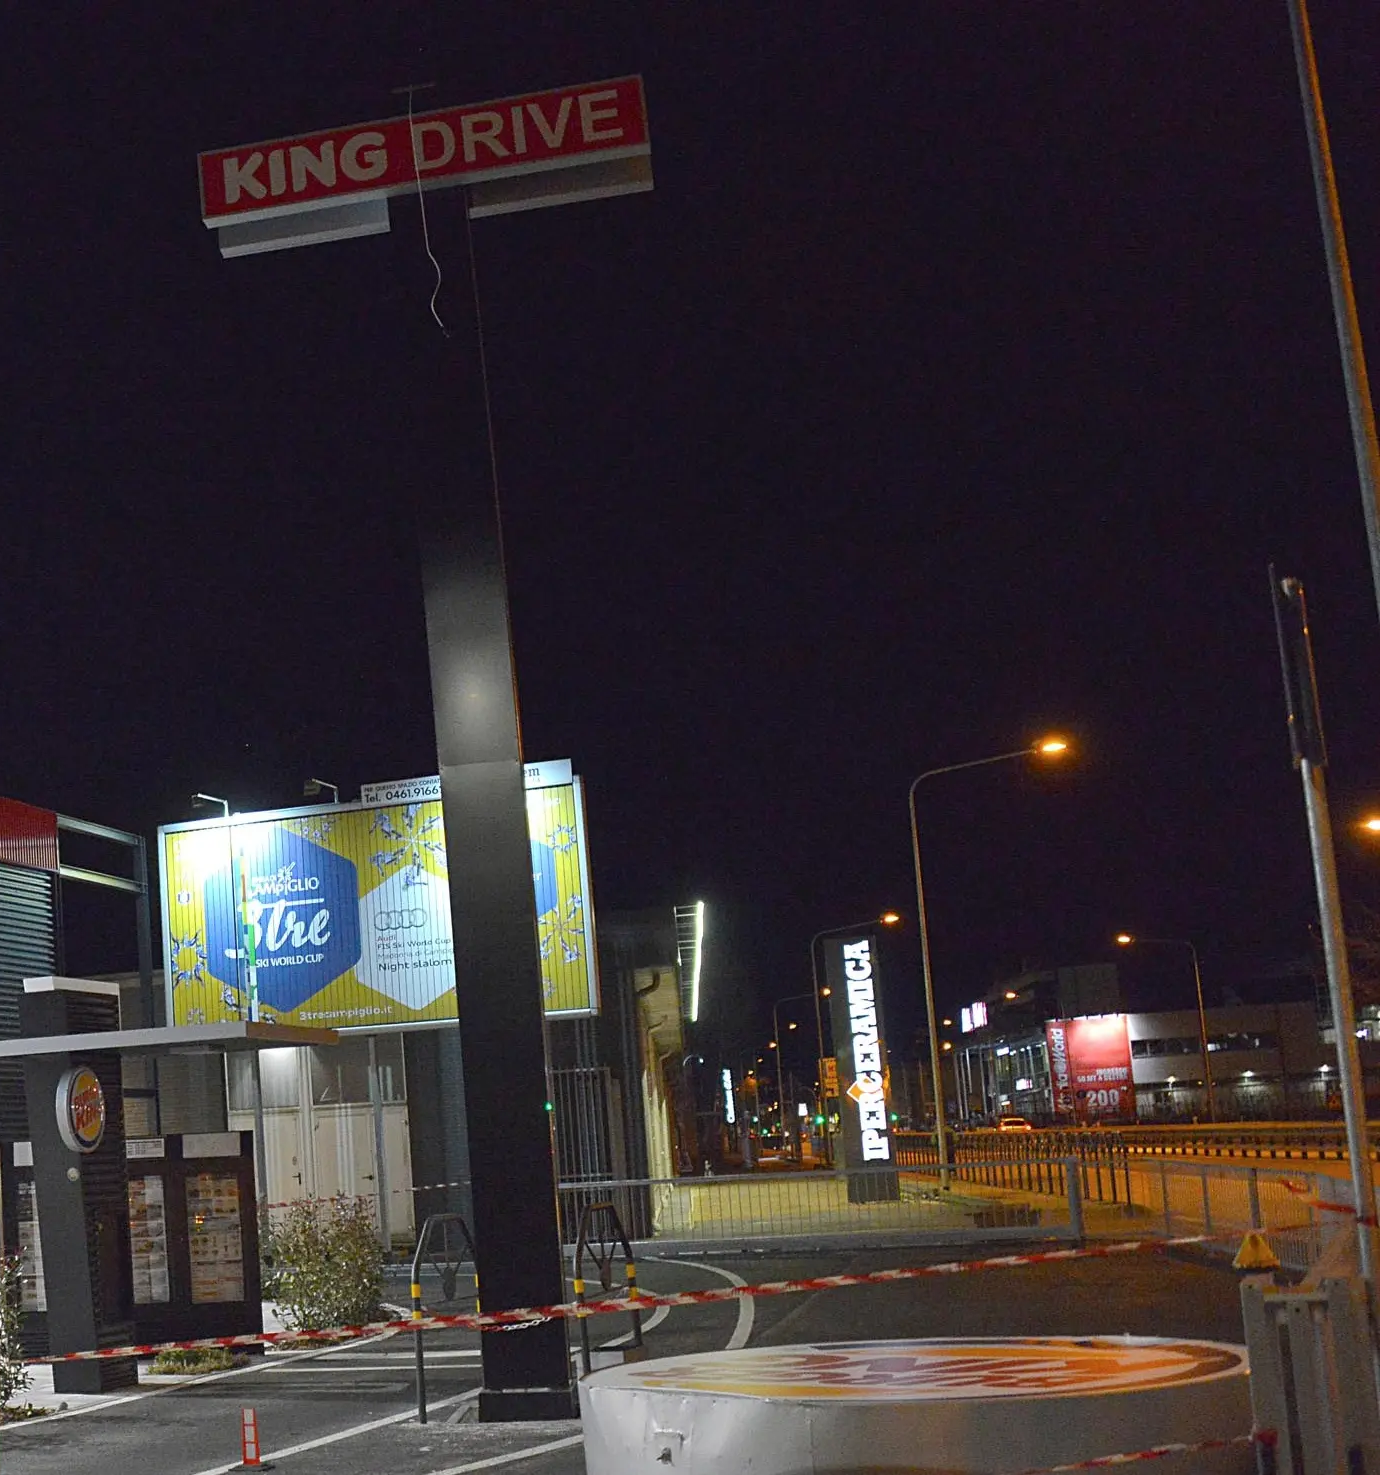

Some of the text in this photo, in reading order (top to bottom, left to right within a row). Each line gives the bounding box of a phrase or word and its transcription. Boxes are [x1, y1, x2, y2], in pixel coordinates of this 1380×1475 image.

[222, 89, 624, 204] KING DRIVE
[364, 785, 442, 803] Tel. 0461.9166
[407, 939, 433, 947] World
[434, 937, 452, 945] Cup
[256, 953, 325, 969] SKI WORLD CUP
[378, 958, 453, 972] Night slalom
[843, 939, 890, 1161] IPERCERAMICA
[1086, 1088, 1119, 1107] 200
